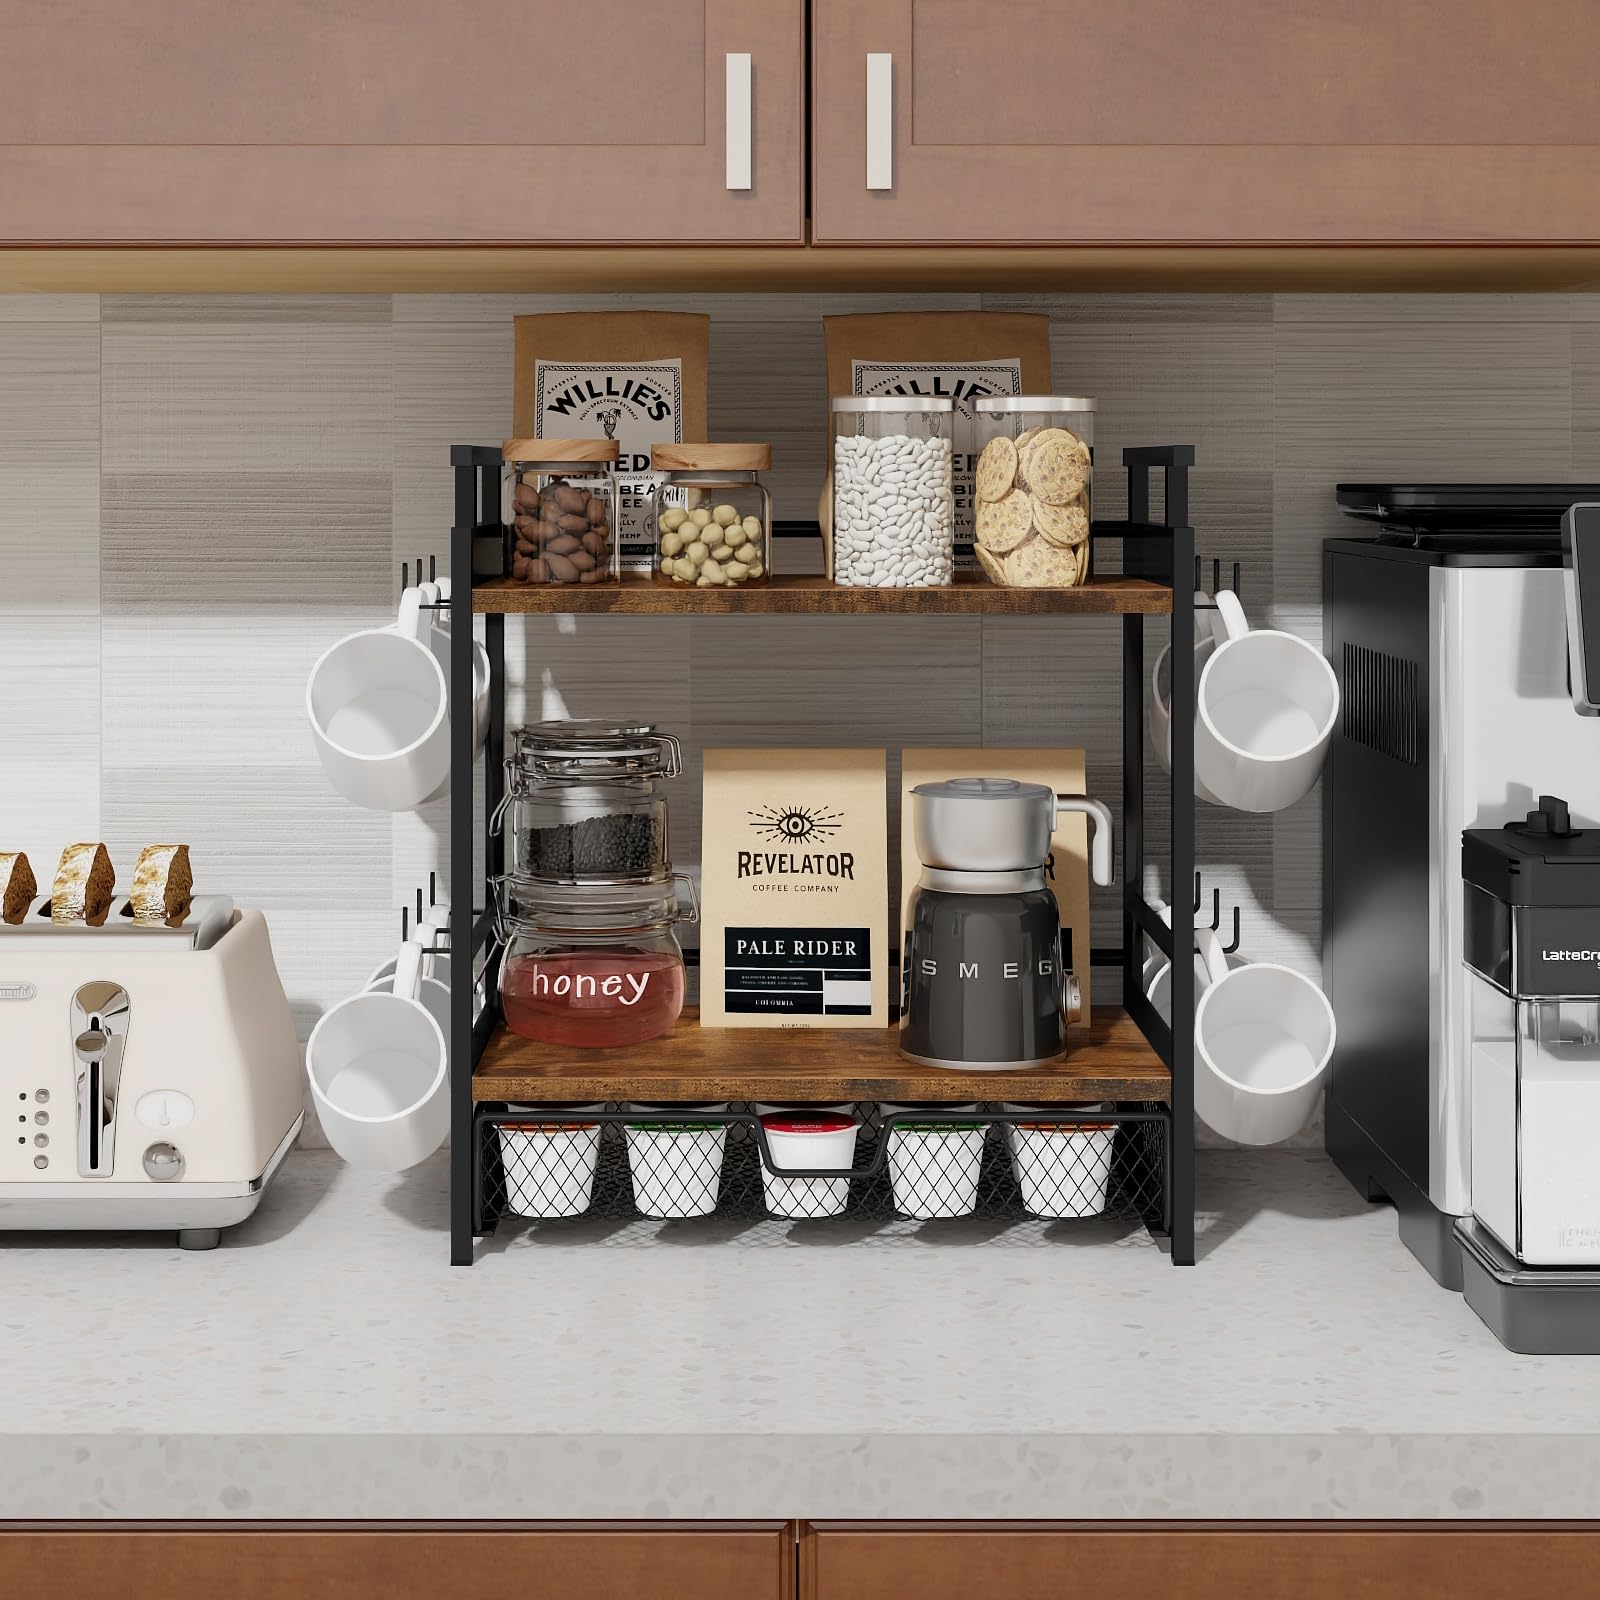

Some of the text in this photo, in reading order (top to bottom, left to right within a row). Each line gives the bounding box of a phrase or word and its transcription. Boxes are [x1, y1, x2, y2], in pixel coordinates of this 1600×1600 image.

[547, 375, 577, 395] EXPERTLY
[645, 376, 672, 396] SOURCED
[978, 376, 1010, 395] SOURCED
[546, 376, 671, 421] WILLIE'S
[737, 851, 854, 881] REVELATOR
[752, 884, 839, 893] COFFEE COMPANY
[736, 940, 857, 956] PALE RIDER
[921, 959, 1053, 979] SMEG
[532, 964, 650, 1006] honey
[755, 999, 794, 1007] COLOMBIA
